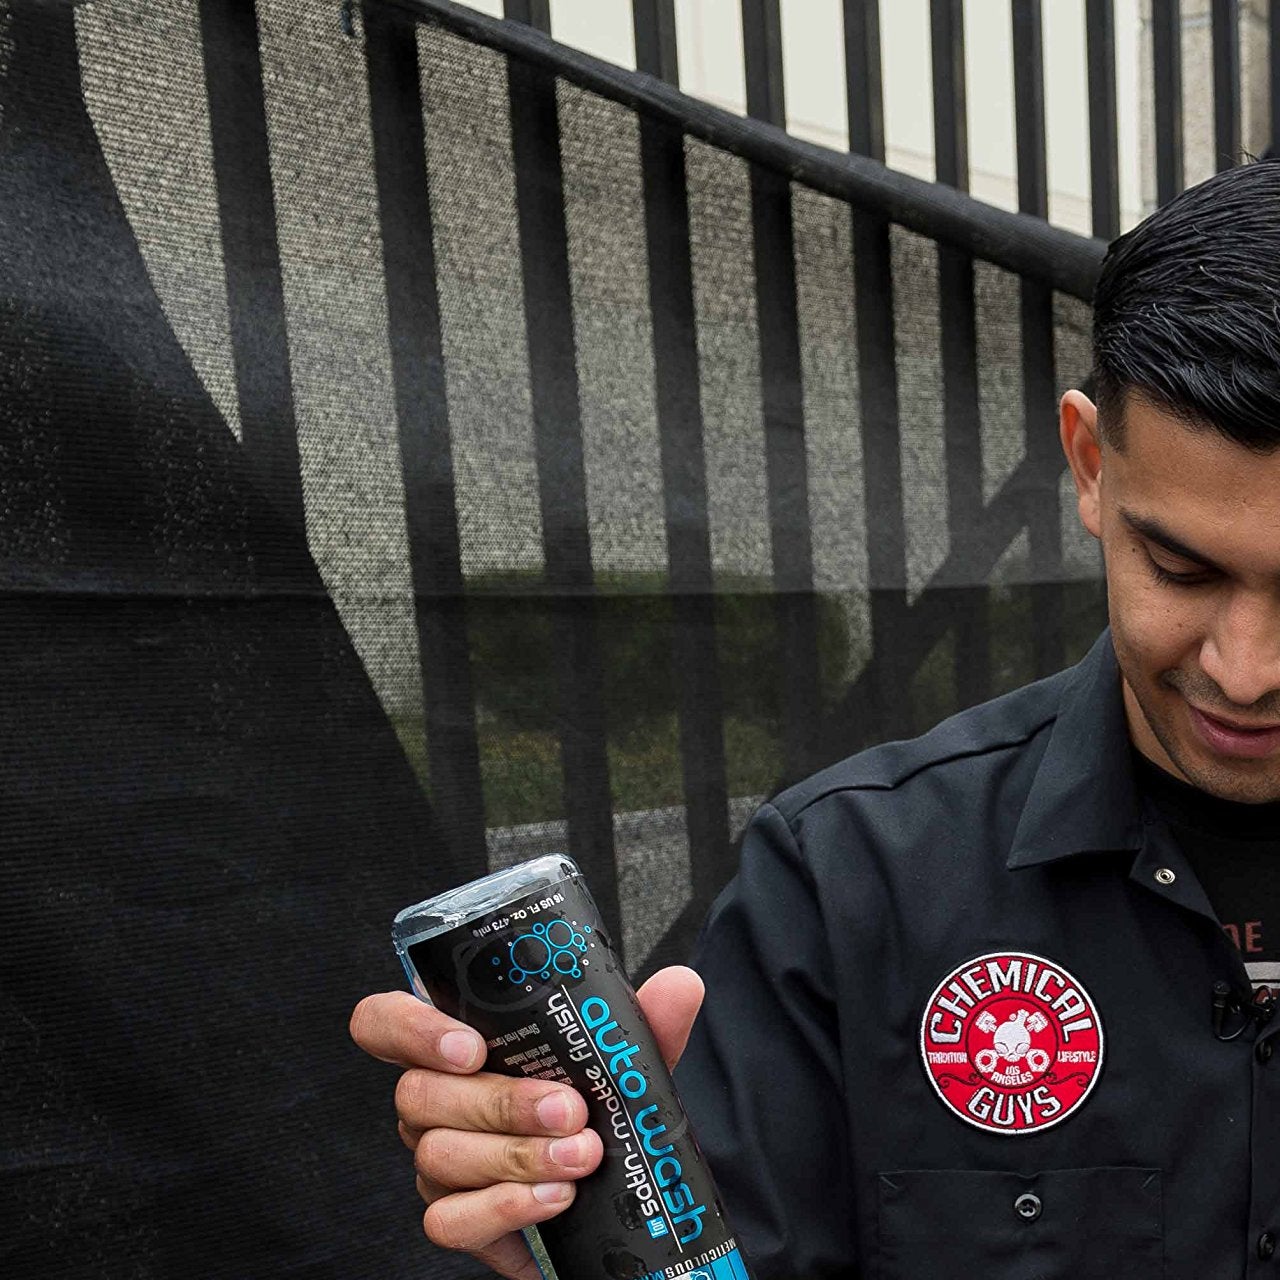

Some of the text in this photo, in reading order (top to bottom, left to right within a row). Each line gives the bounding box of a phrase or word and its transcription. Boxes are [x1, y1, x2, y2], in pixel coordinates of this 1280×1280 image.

[540, 897, 555, 909] US
[552, 893, 565, 904] 16
[509, 909, 527, 920] Oz.
[491, 917, 510, 931] 473
[929, 959, 1093, 1044] CHEMICAL
[927, 1051, 968, 1064] TRADITION
[1057, 1050, 1096, 1063] LIFESTYLE
[1004, 1065, 1021, 1075] LOS
[991, 1071, 1034, 1086] ANGELES
[967, 1085, 1062, 1126] GUYS
[545, 991, 667, 1237] for satin-matte finish
[580, 996, 708, 1246] auto wash
